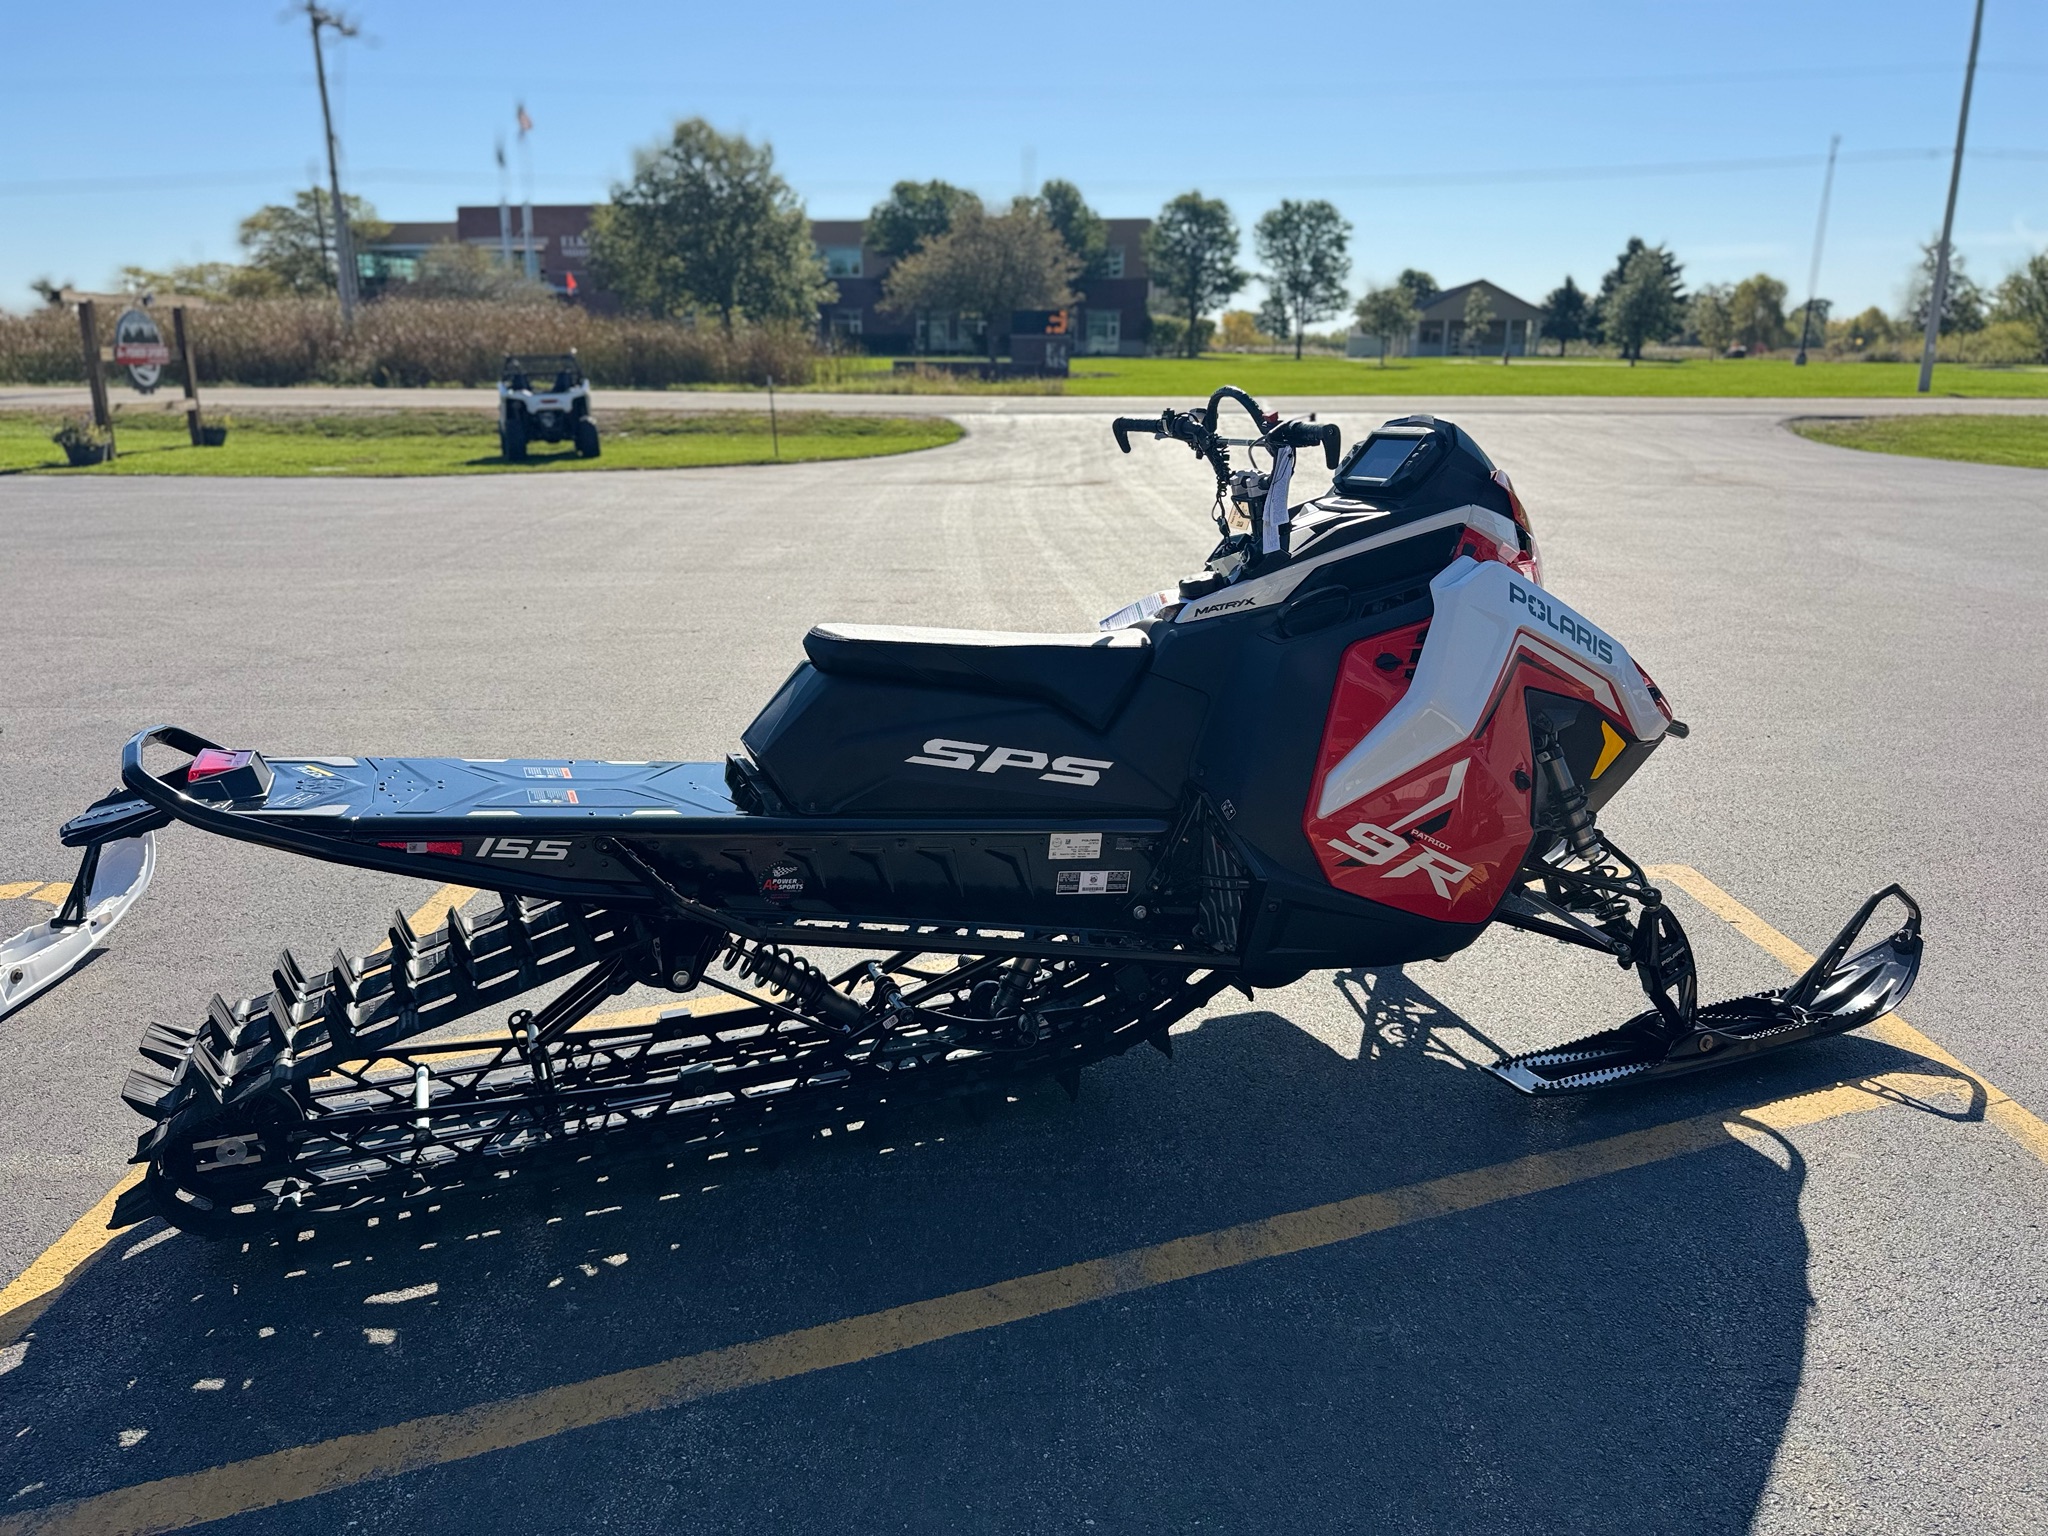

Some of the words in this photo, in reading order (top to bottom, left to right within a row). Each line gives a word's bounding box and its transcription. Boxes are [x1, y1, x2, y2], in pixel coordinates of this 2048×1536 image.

[1194, 597, 1256, 617] MATRYX
[1509, 581, 1613, 665] POLARIS
[904, 738, 1114, 787] SPS
[475, 837, 573, 861] 155
[1410, 828, 1453, 852] PATRIOT
[763, 879, 779, 890] A+
